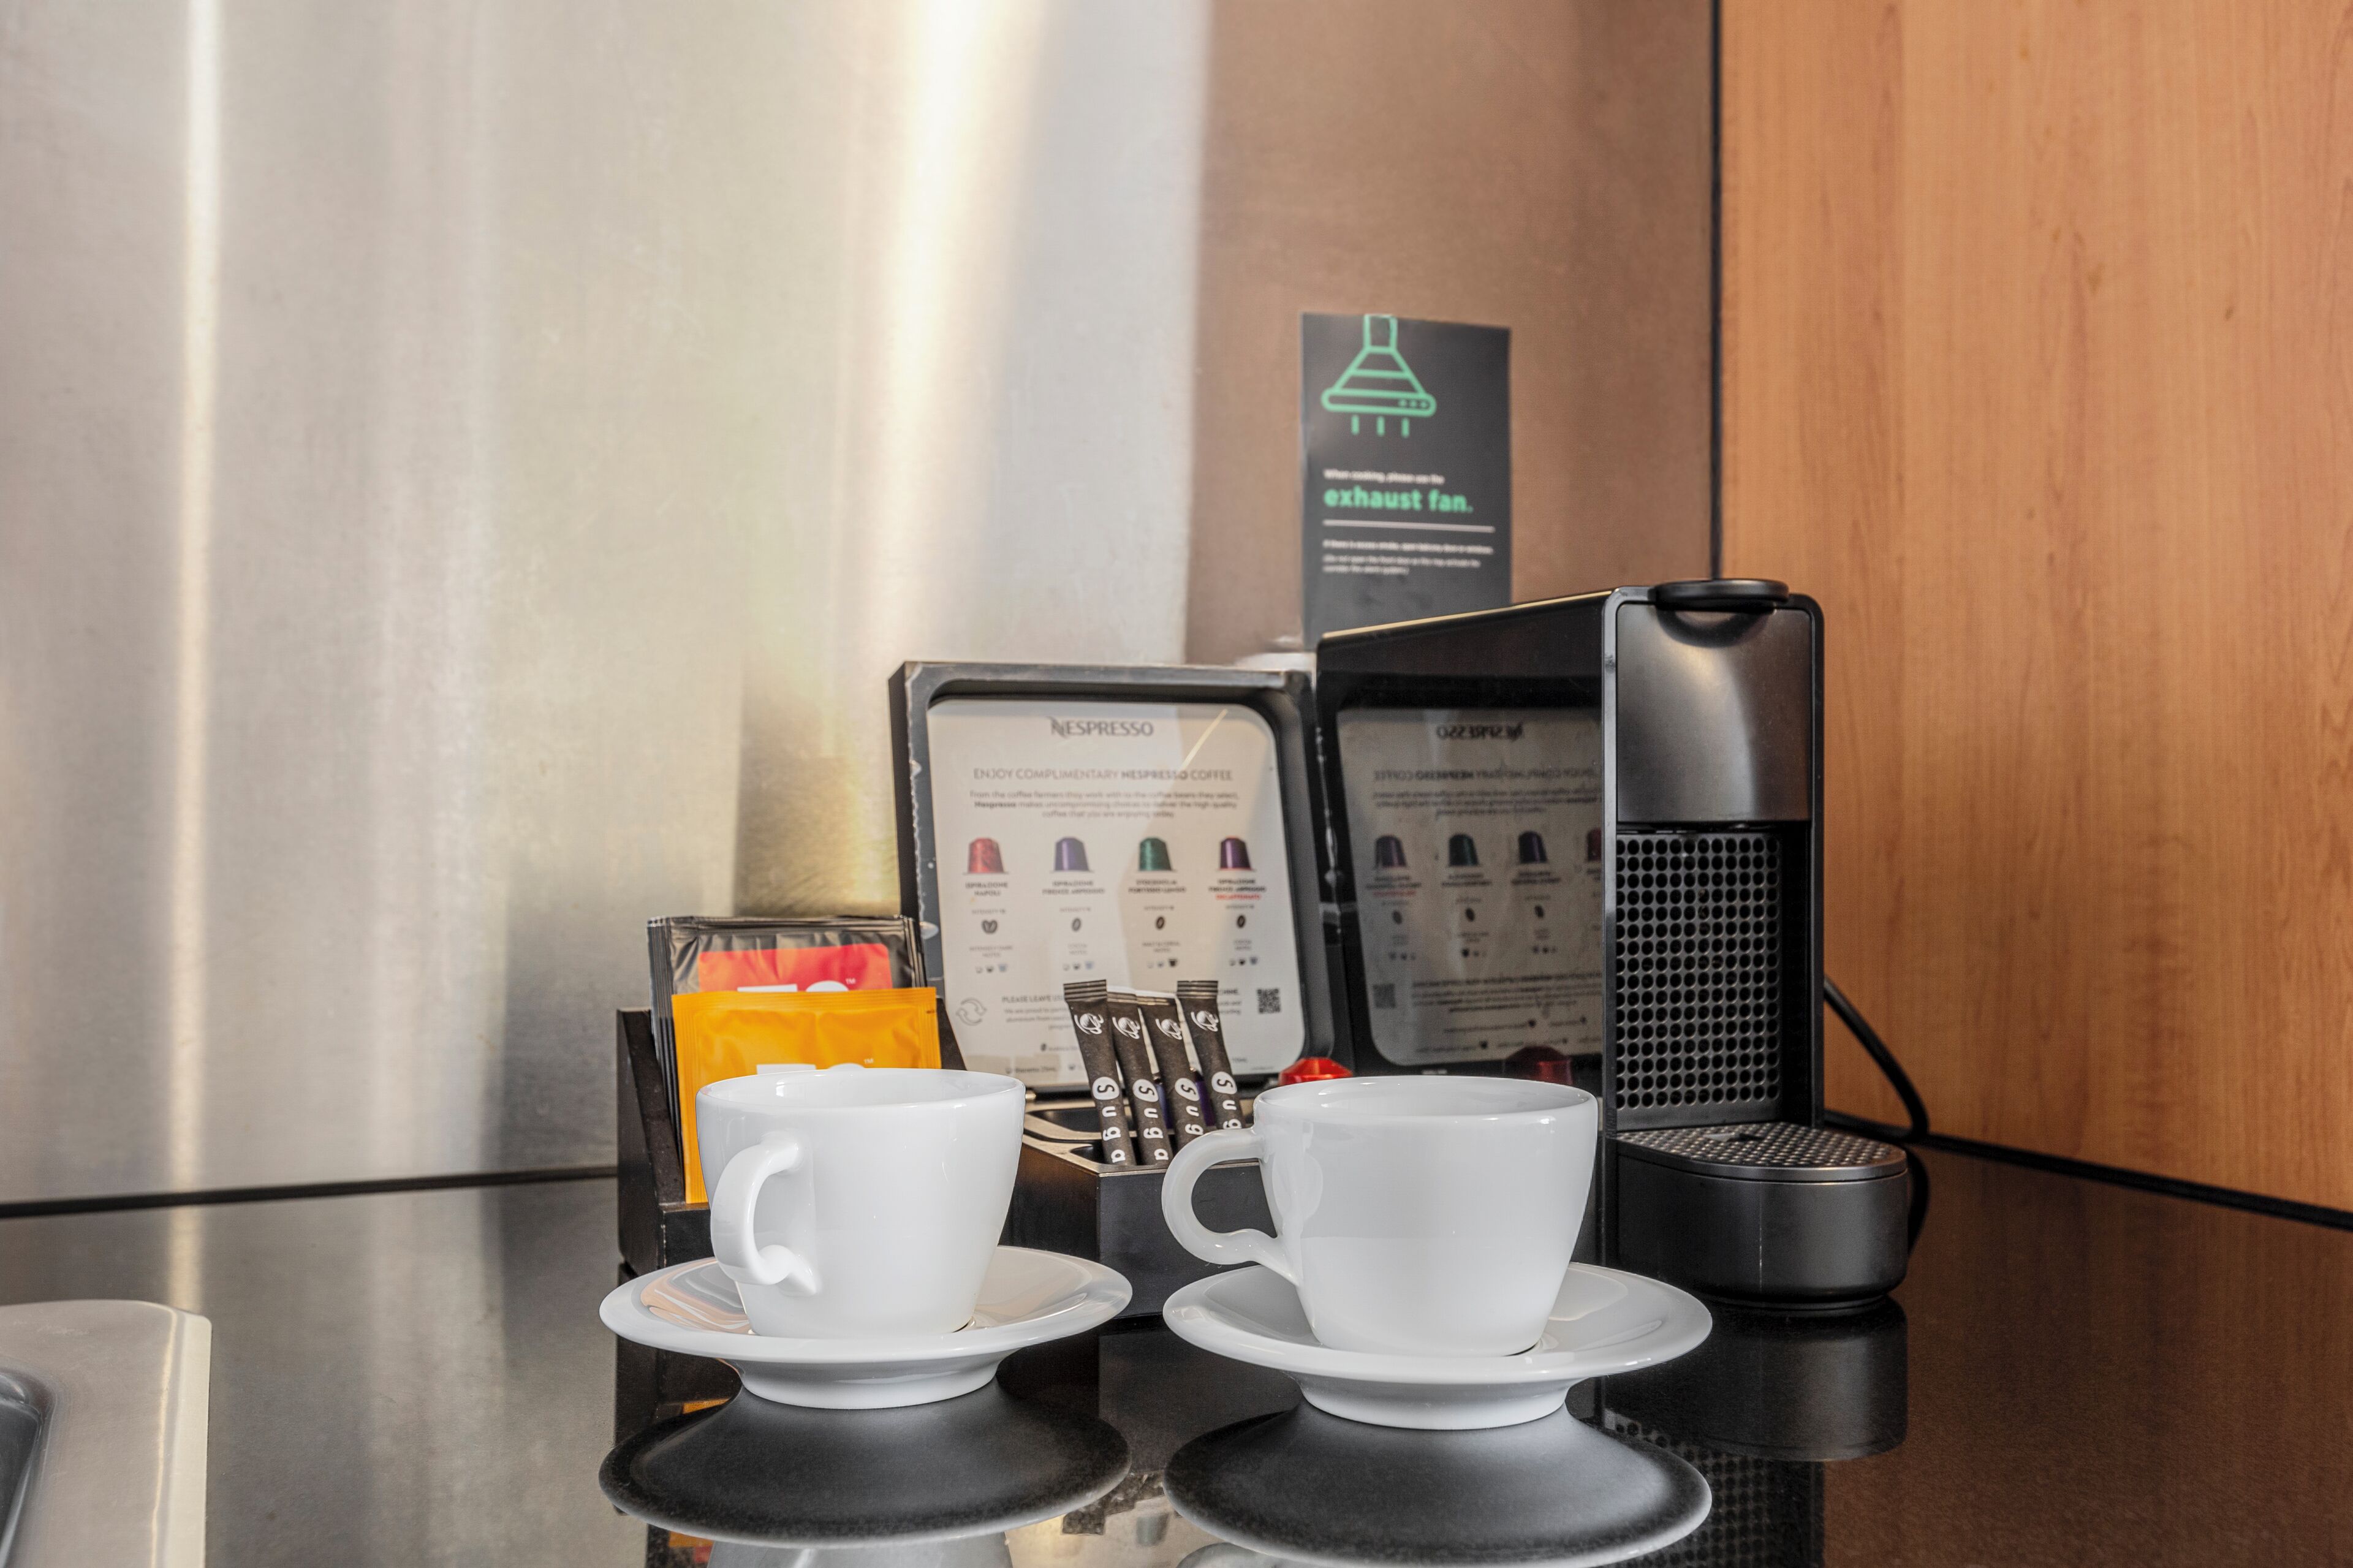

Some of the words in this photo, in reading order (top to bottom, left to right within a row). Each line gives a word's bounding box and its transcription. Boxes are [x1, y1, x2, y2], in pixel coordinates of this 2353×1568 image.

[1324, 484, 1422, 511] exhaust
[1428, 488, 1474, 513] fan.
[1046, 716, 1154, 739] NESPRESSO
[973, 768, 1013, 779] ENJOY
[1015, 768, 1118, 780] COMPLIMENTARY
[1121, 770, 1188, 780] NESPRESSO
[1190, 770, 1233, 781] COFFEE
[1096, 1081, 1126, 1163] Suga
[1137, 1083, 1169, 1161] Suga
[1180, 1082, 1205, 1135] Sug
[1217, 1077, 1242, 1129] Sug
